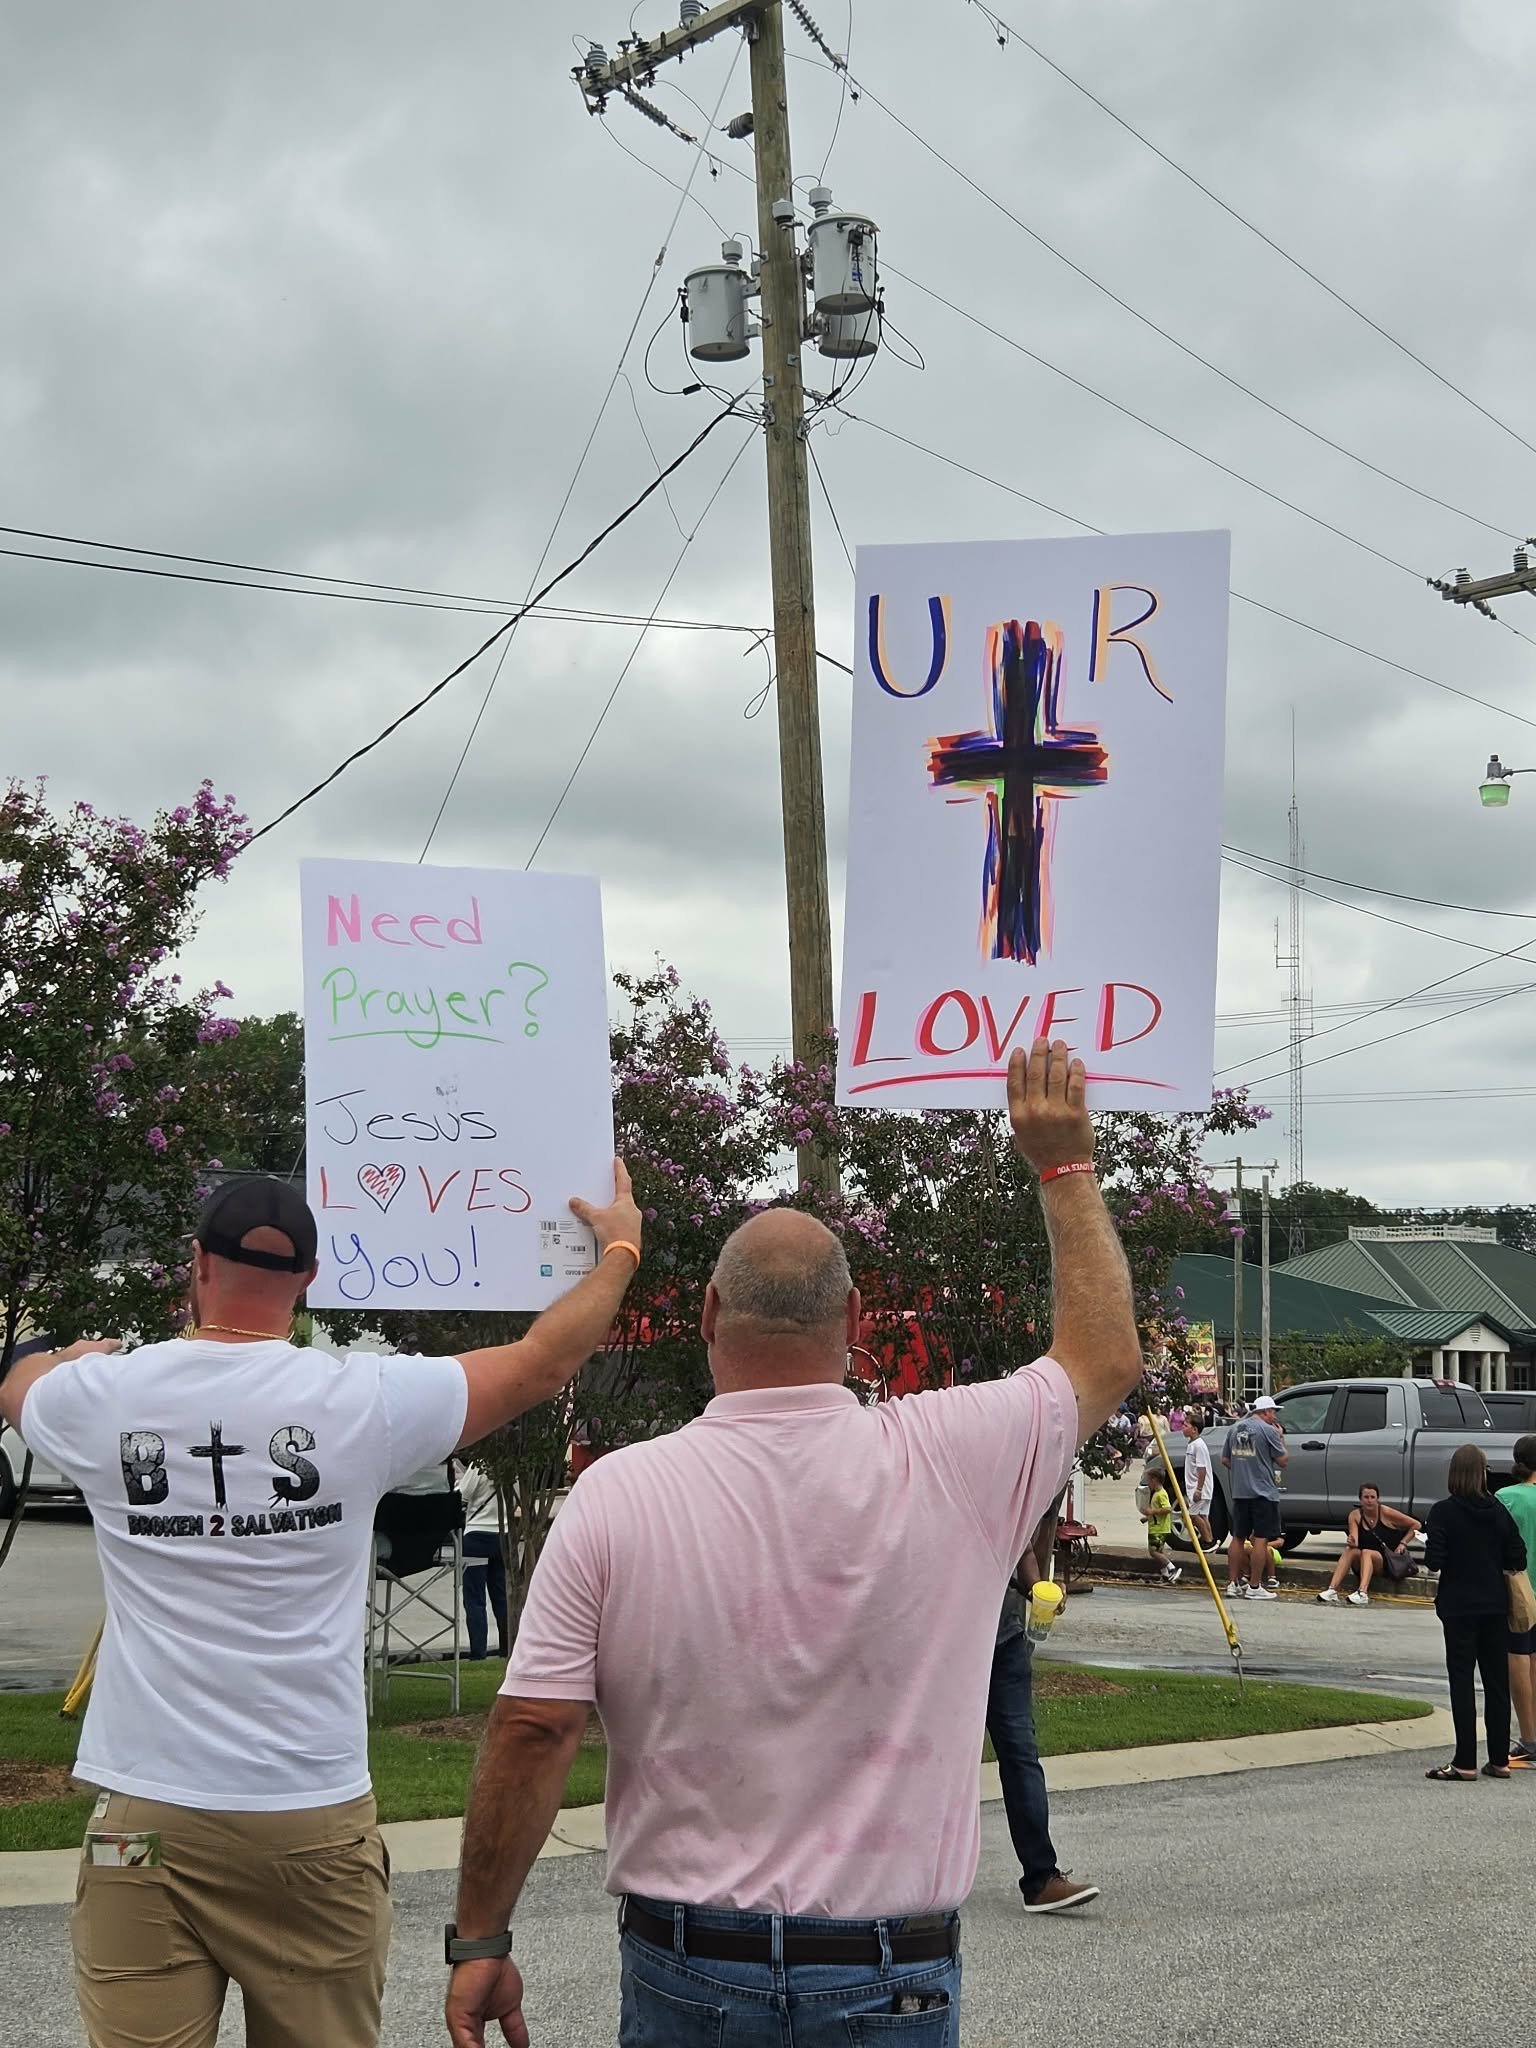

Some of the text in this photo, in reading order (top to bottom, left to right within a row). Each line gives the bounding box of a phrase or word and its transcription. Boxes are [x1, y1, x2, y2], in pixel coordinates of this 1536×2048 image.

[868, 582, 1174, 704] U R
[326, 892, 484, 949] Need
[321, 961, 549, 1050] Prayer?
[850, 981, 1163, 1067] LOVED
[315, 1089, 498, 1146] Jesus
[127, 1502, 343, 1537] BROKEN 2 SALVATION
